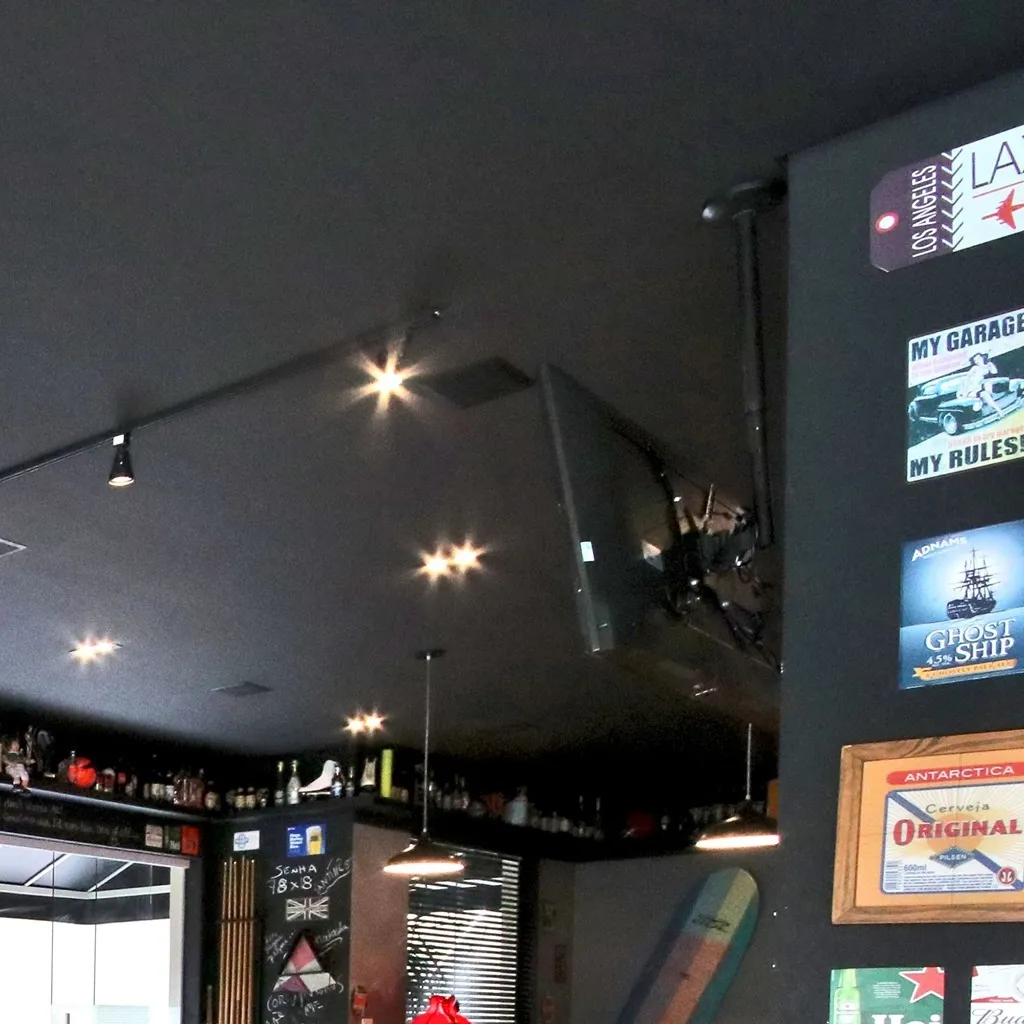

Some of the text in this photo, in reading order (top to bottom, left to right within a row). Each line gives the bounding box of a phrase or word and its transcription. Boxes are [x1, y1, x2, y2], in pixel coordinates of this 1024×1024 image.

[971, 135, 1024, 190] LA
[912, 164, 937, 258] LOS ANGELES
[911, 335, 944, 362] MY
[910, 453, 943, 477] MY
[912, 536, 968, 562] ADNAMS
[925, 619, 1016, 651] GHOST
[955, 637, 1015, 663] SHIP
[904, 765, 1015, 783] ANTARCTICA
[925, 801, 990, 814] Cerveja
[893, 818, 1023, 846] ORIGINAL
[270, 864, 317, 880] SENHA
